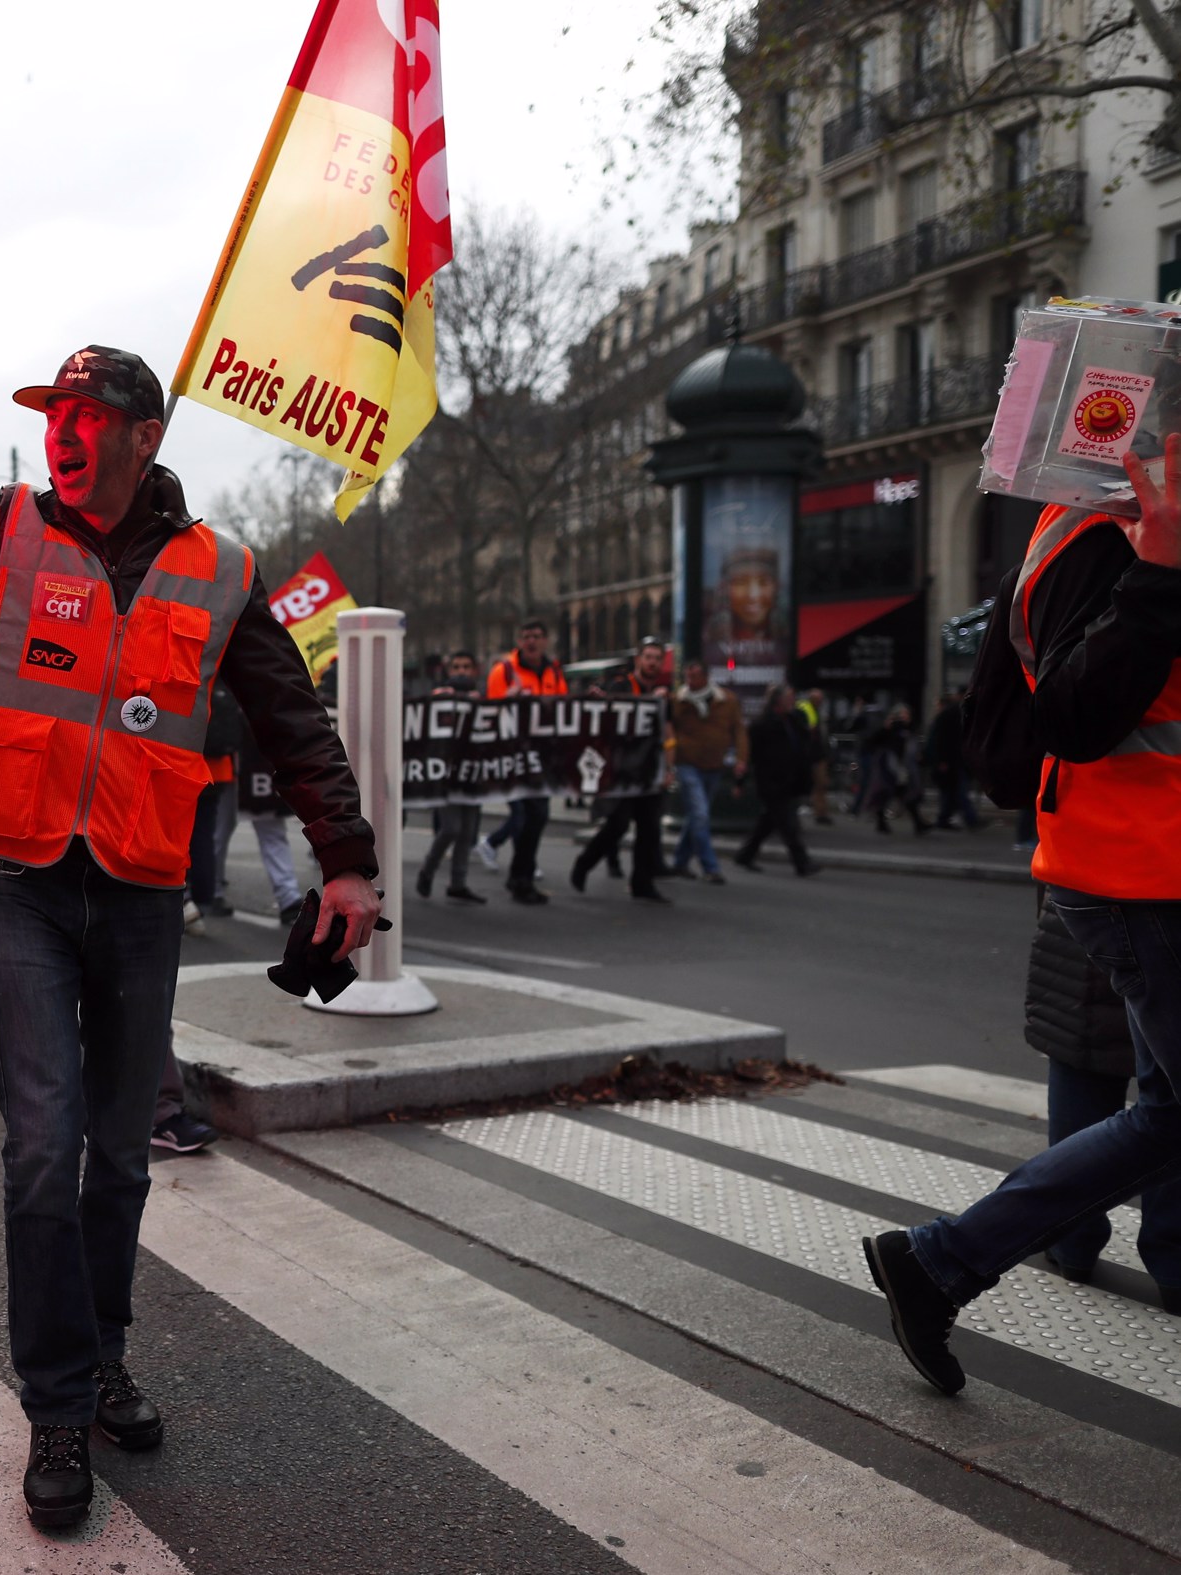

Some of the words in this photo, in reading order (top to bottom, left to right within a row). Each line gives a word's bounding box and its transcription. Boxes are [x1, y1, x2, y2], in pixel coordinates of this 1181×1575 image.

[323, 161, 375, 195] DES
[202, 337, 285, 416] Paris
[45, 598, 82, 620] cgt
[28, 649, 75, 667] SNCF
[529, 701, 657, 736] LUTTE
